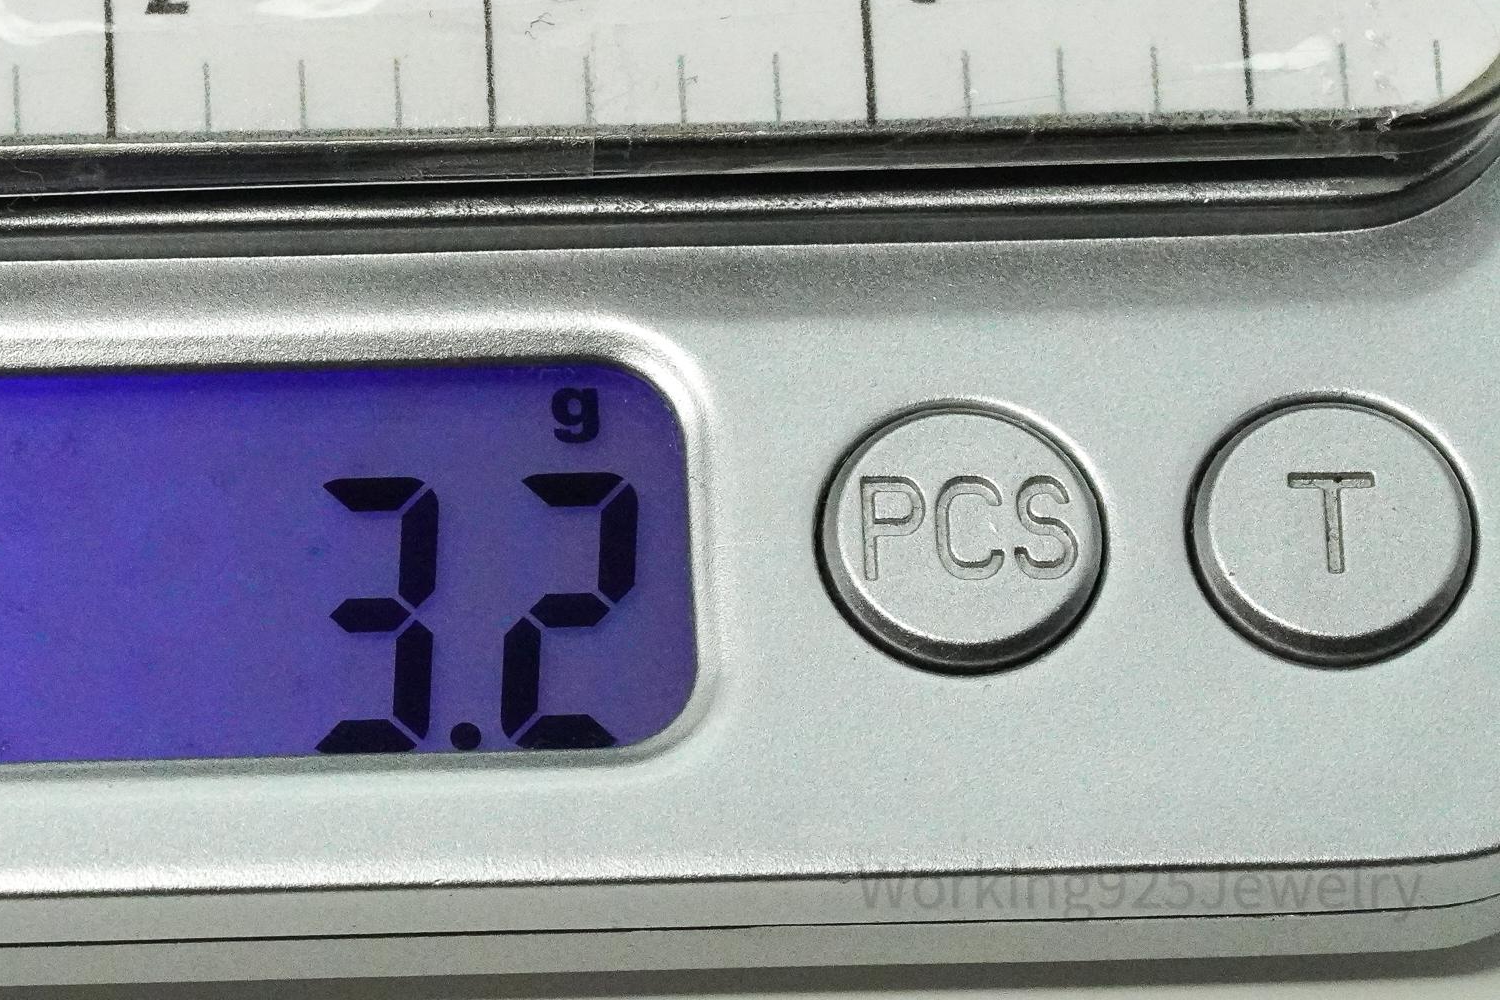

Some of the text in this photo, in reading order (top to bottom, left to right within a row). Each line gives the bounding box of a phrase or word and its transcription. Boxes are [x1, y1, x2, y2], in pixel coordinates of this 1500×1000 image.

[551, 387, 600, 443] g
[860, 475, 1077, 580] PCS
[1286, 471, 1375, 574] T
[315, 472, 638, 753] 3.2
